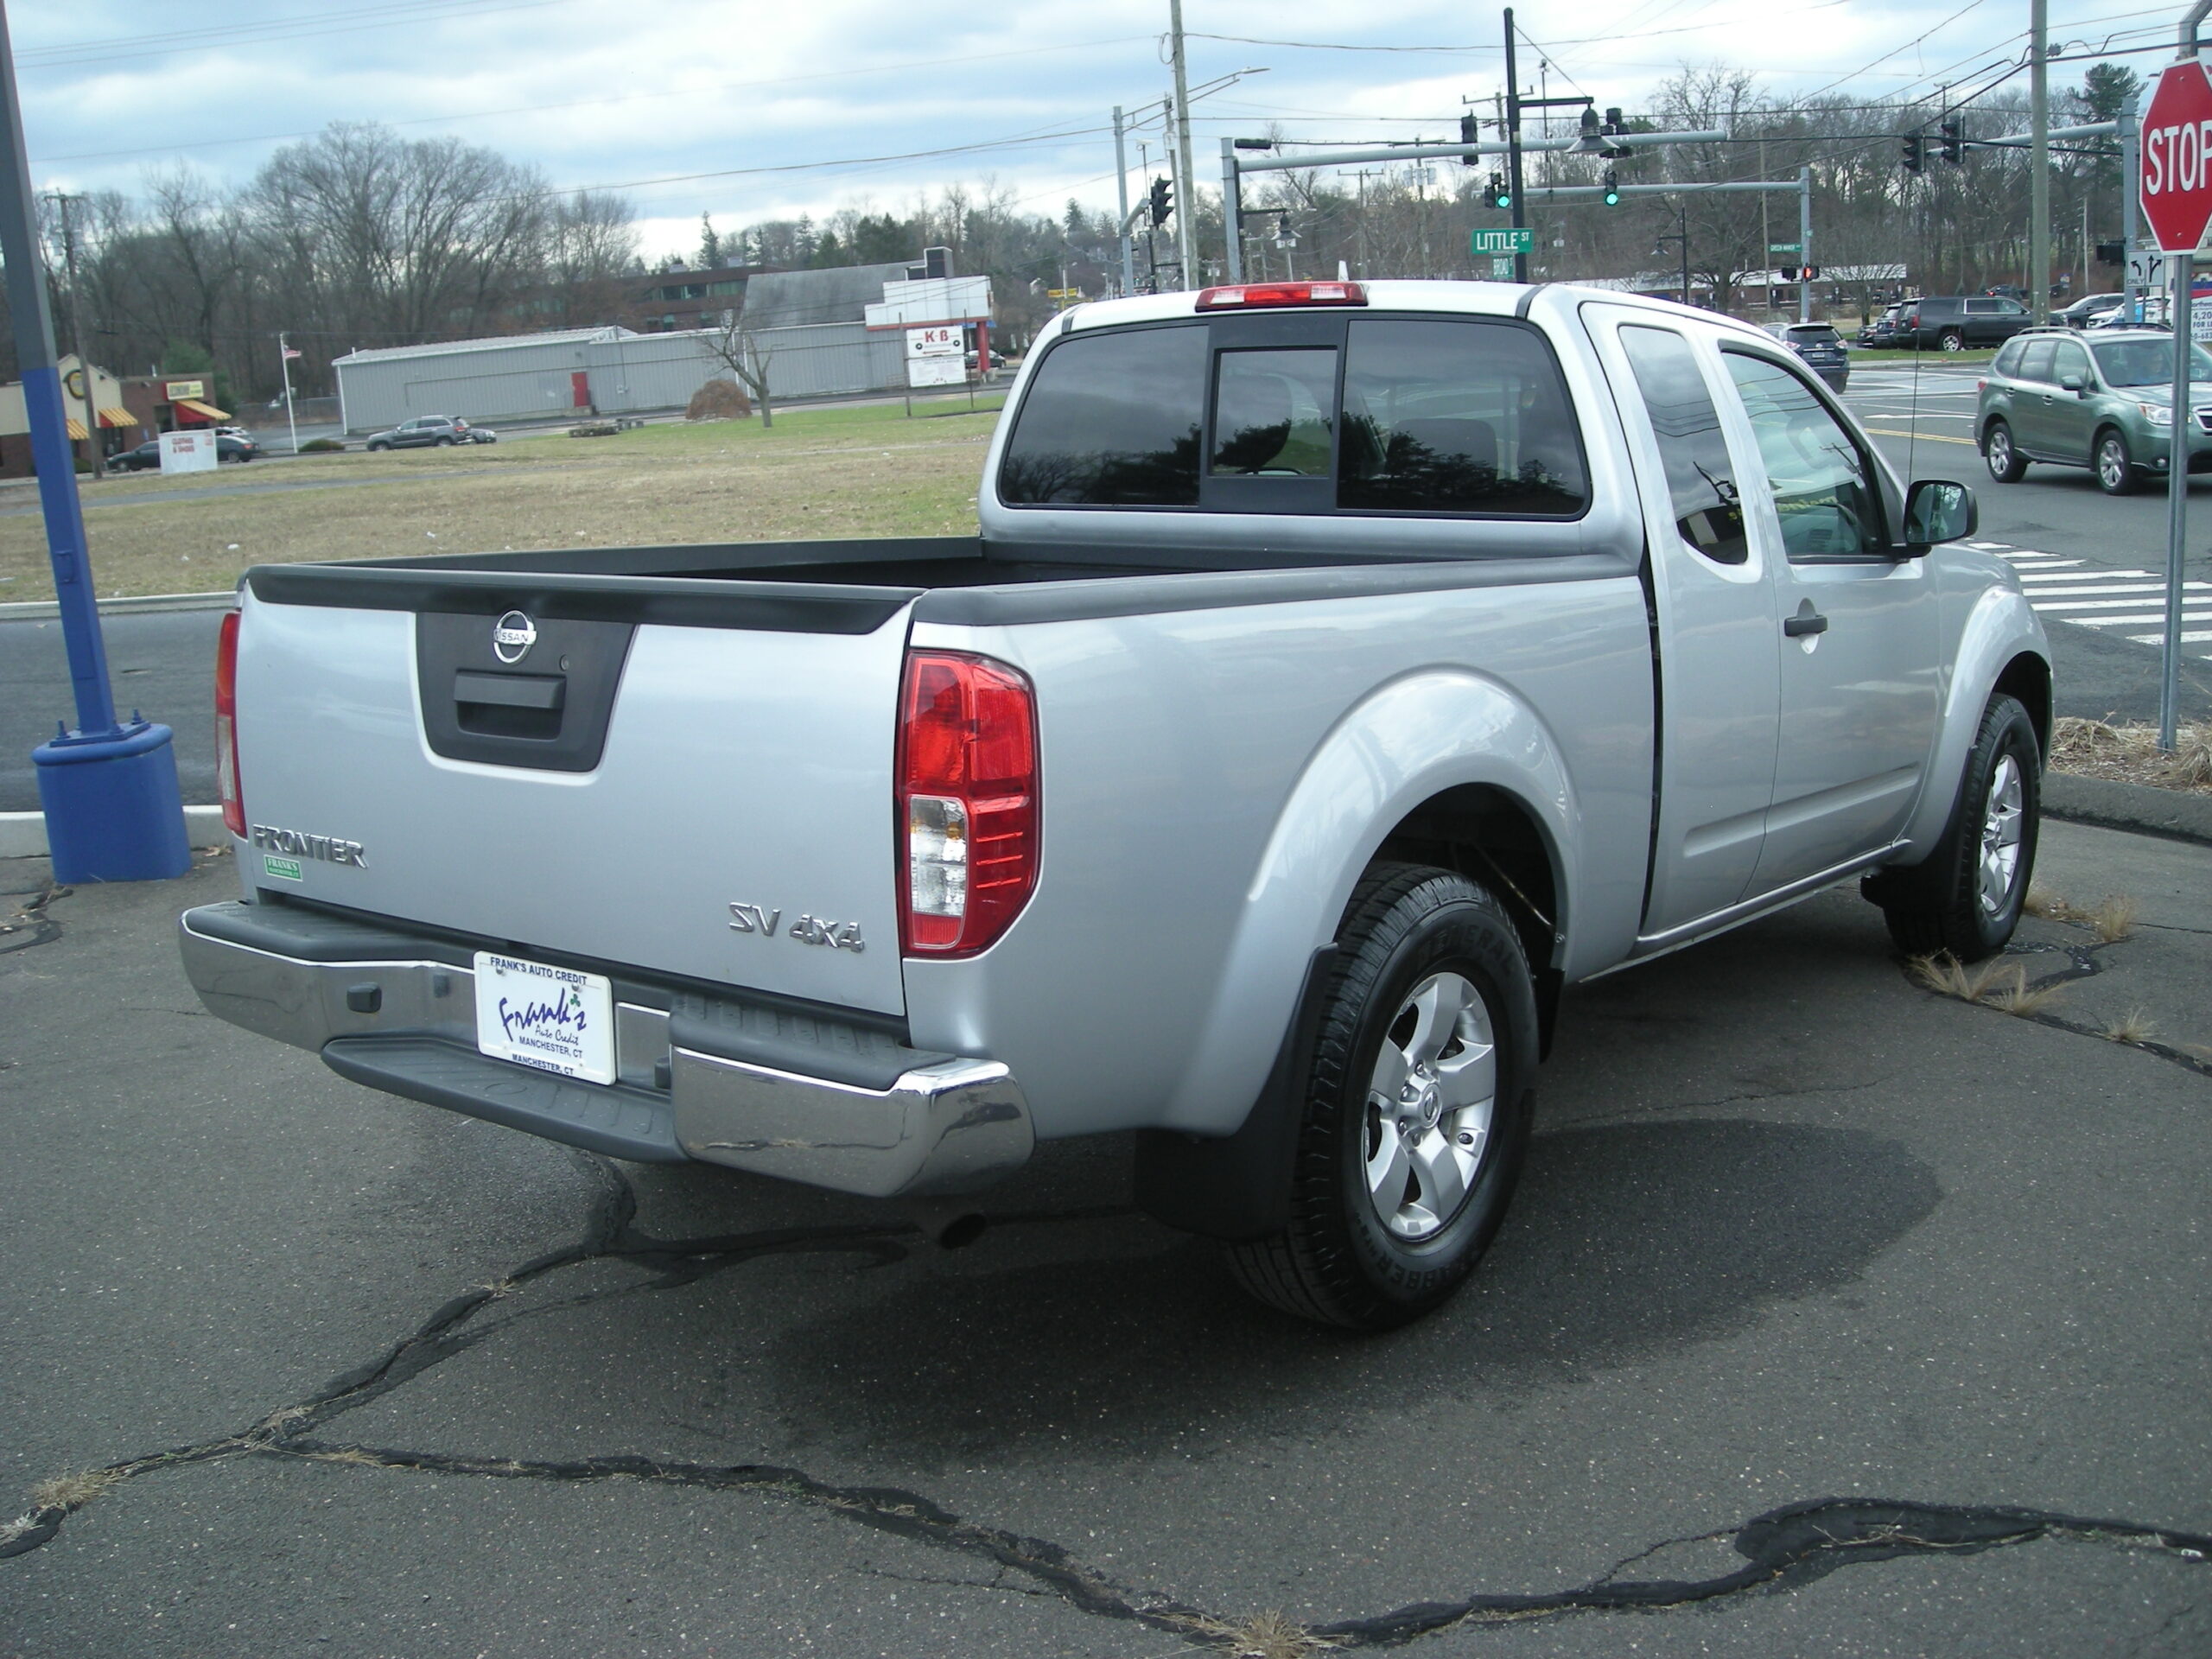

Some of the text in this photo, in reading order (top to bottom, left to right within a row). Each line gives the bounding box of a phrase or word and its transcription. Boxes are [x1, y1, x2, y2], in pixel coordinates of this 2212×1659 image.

[2145, 120, 2212, 195] STOP
[1477, 232, 1529, 250] LITTLE ST
[494, 630, 529, 642] NISSAN
[252, 823, 370, 869] FRONTIER
[267, 857, 299, 870] FRANK'S
[729, 901, 781, 937] SV
[490, 957, 588, 985] FRANK'S AUTO CREDIT
[499, 988, 587, 1042] Frank's
[535, 1024, 579, 1046] Auto Credit
[519, 1036, 582, 1058] MANCHESTER, CT
[512, 1053, 574, 1075] MANCHESTER, CT
